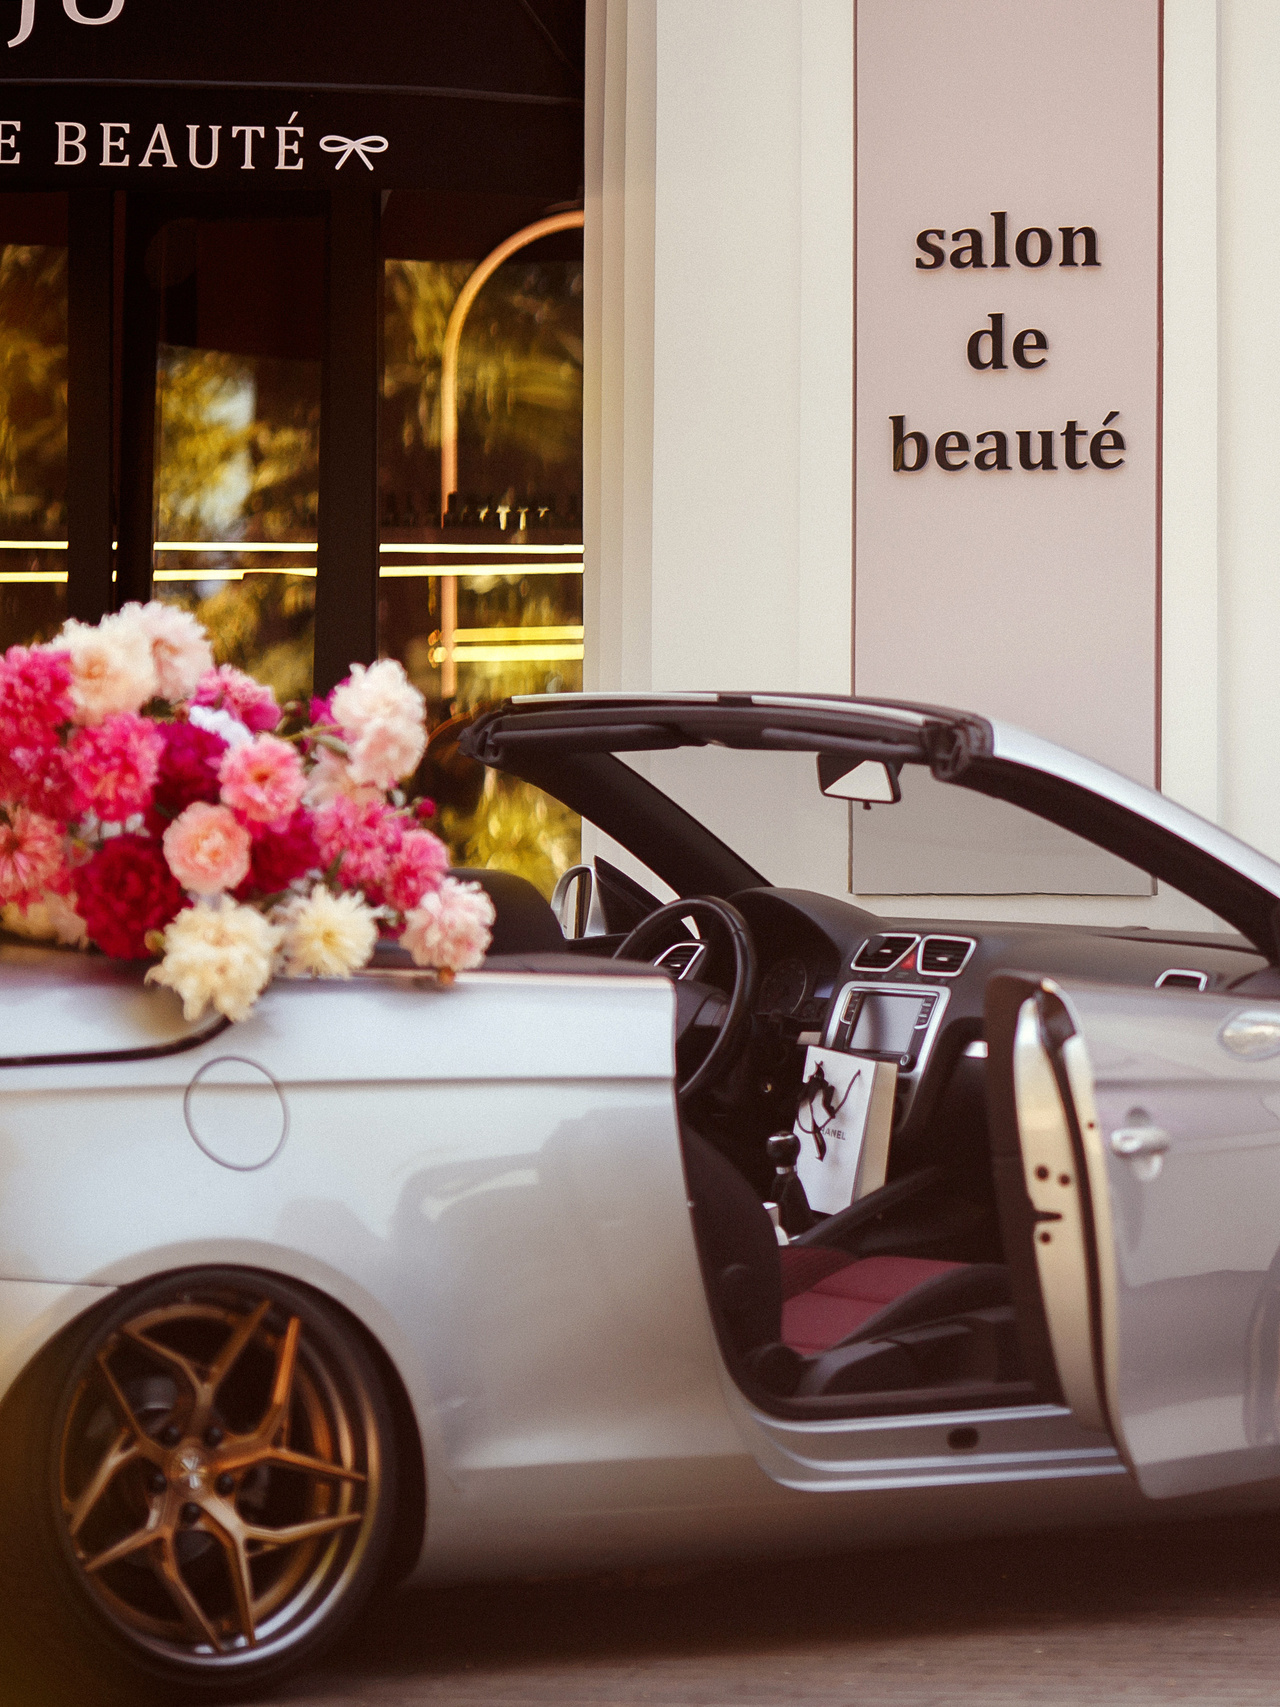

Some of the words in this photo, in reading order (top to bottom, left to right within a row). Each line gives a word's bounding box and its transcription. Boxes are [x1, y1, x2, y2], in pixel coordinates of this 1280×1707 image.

[54, 111, 304, 170] BEAUTÉ
[915, 211, 1102, 271] salon
[967, 312, 1049, 371] de
[888, 410, 1127, 473] beauté
